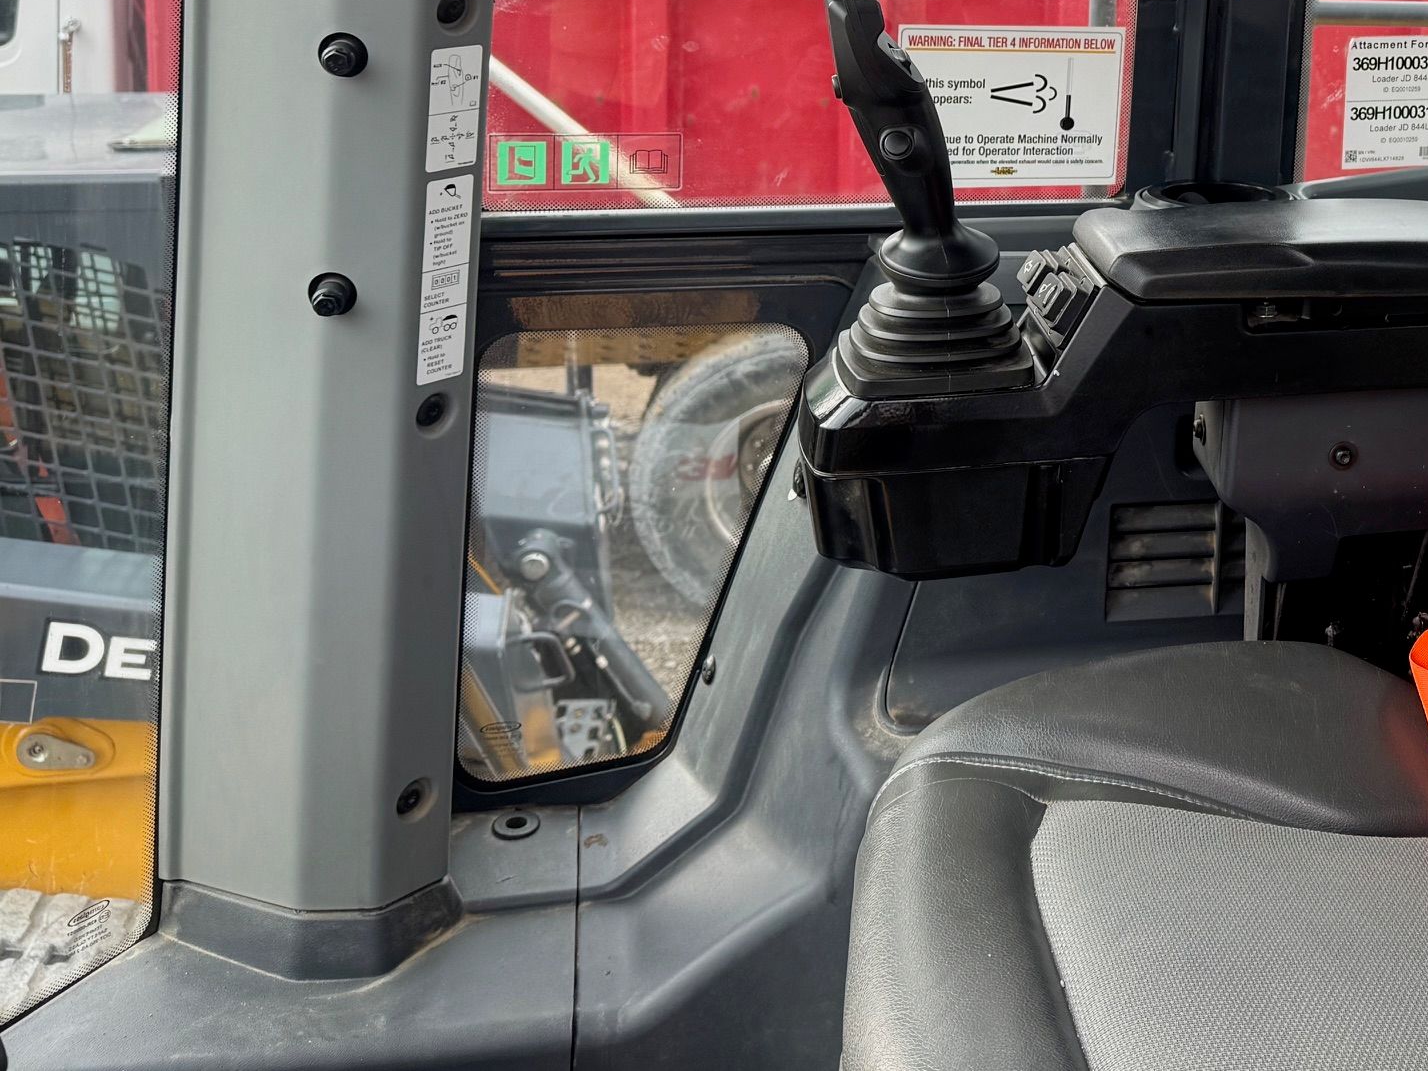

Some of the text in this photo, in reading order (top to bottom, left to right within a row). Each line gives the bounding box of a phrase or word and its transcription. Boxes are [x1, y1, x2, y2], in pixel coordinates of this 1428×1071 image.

[908, 35, 1116, 50] WARNING: FINAL TIER 4 INFORMATION BELOW
[1351, 41, 1407, 50] Attacment
[947, 78, 985, 90] symbol
[965, 135, 974, 144] to
[977, 134, 1014, 146] Operate
[1018, 134, 1058, 144] Machine
[1061, 134, 1102, 145] Normally
[962, 146, 975, 155] for
[978, 146, 1020, 157] Operator
[1023, 146, 1073, 155] Interaction
[441, 204, 463, 213] BUCKET
[424, 292, 444, 301] SELECT
[424, 298, 449, 308] COUNTER
[427, 359, 444, 367] RESET
[426, 364, 452, 374] COUNTER
[41, 621, 158, 680] DE
